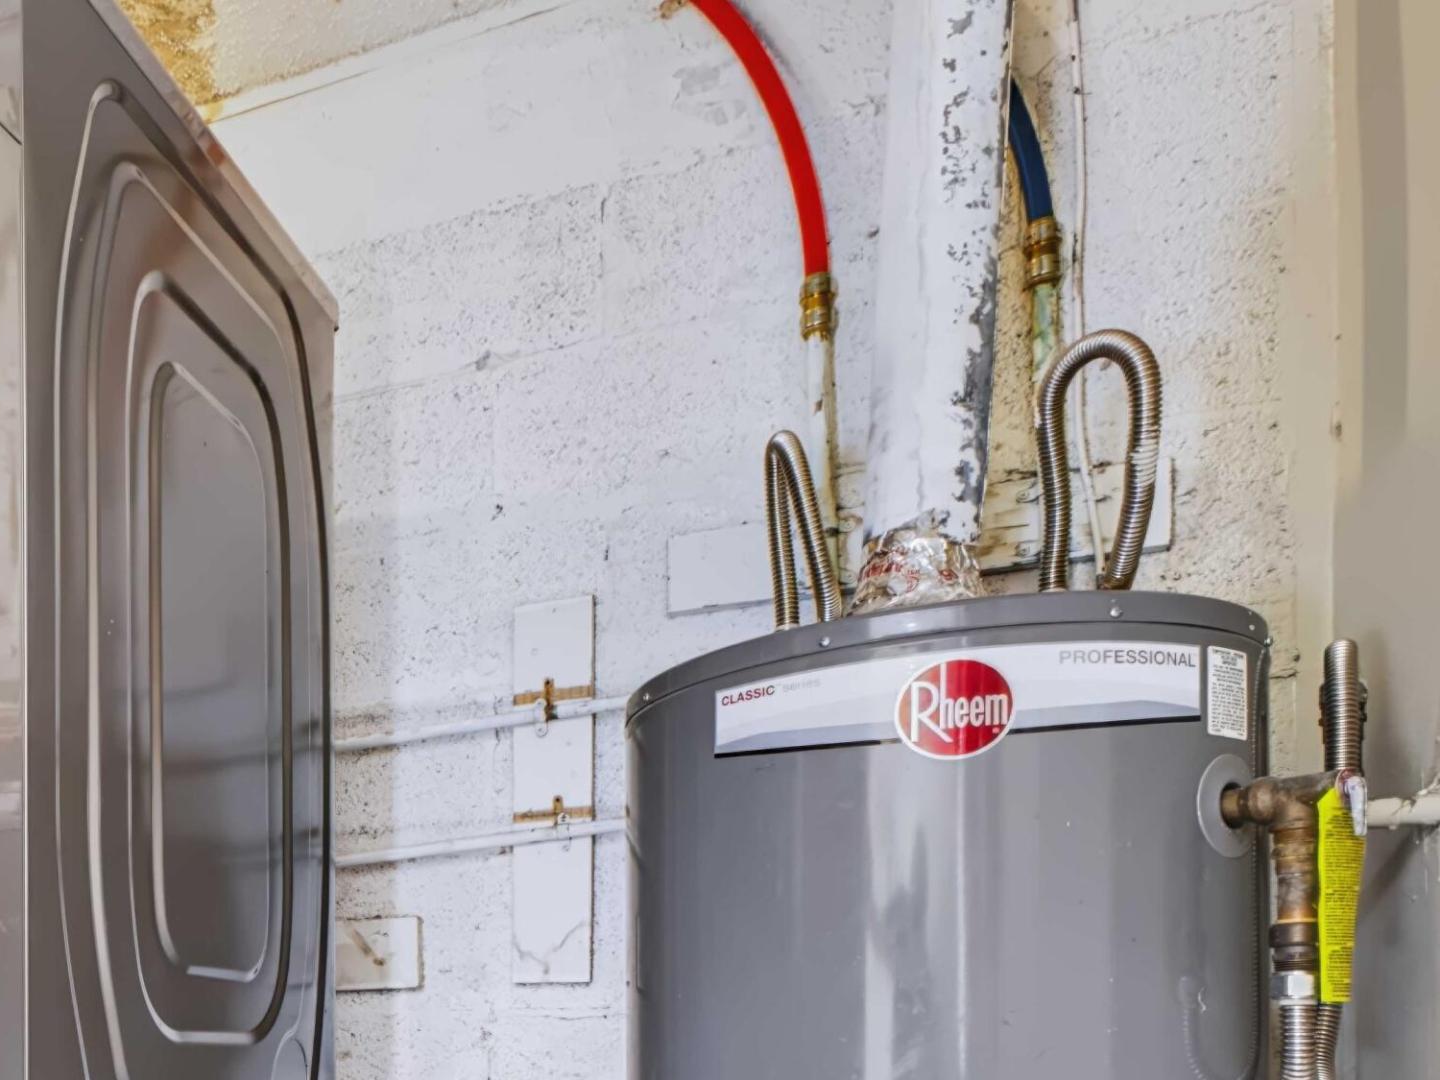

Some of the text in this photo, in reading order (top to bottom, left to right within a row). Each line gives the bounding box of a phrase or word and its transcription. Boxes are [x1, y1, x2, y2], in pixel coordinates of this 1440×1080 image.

[1059, 649, 1197, 669] PROFESSIONAL
[721, 685, 776, 706] CLASSIC
[909, 661, 1009, 744] Rheem
